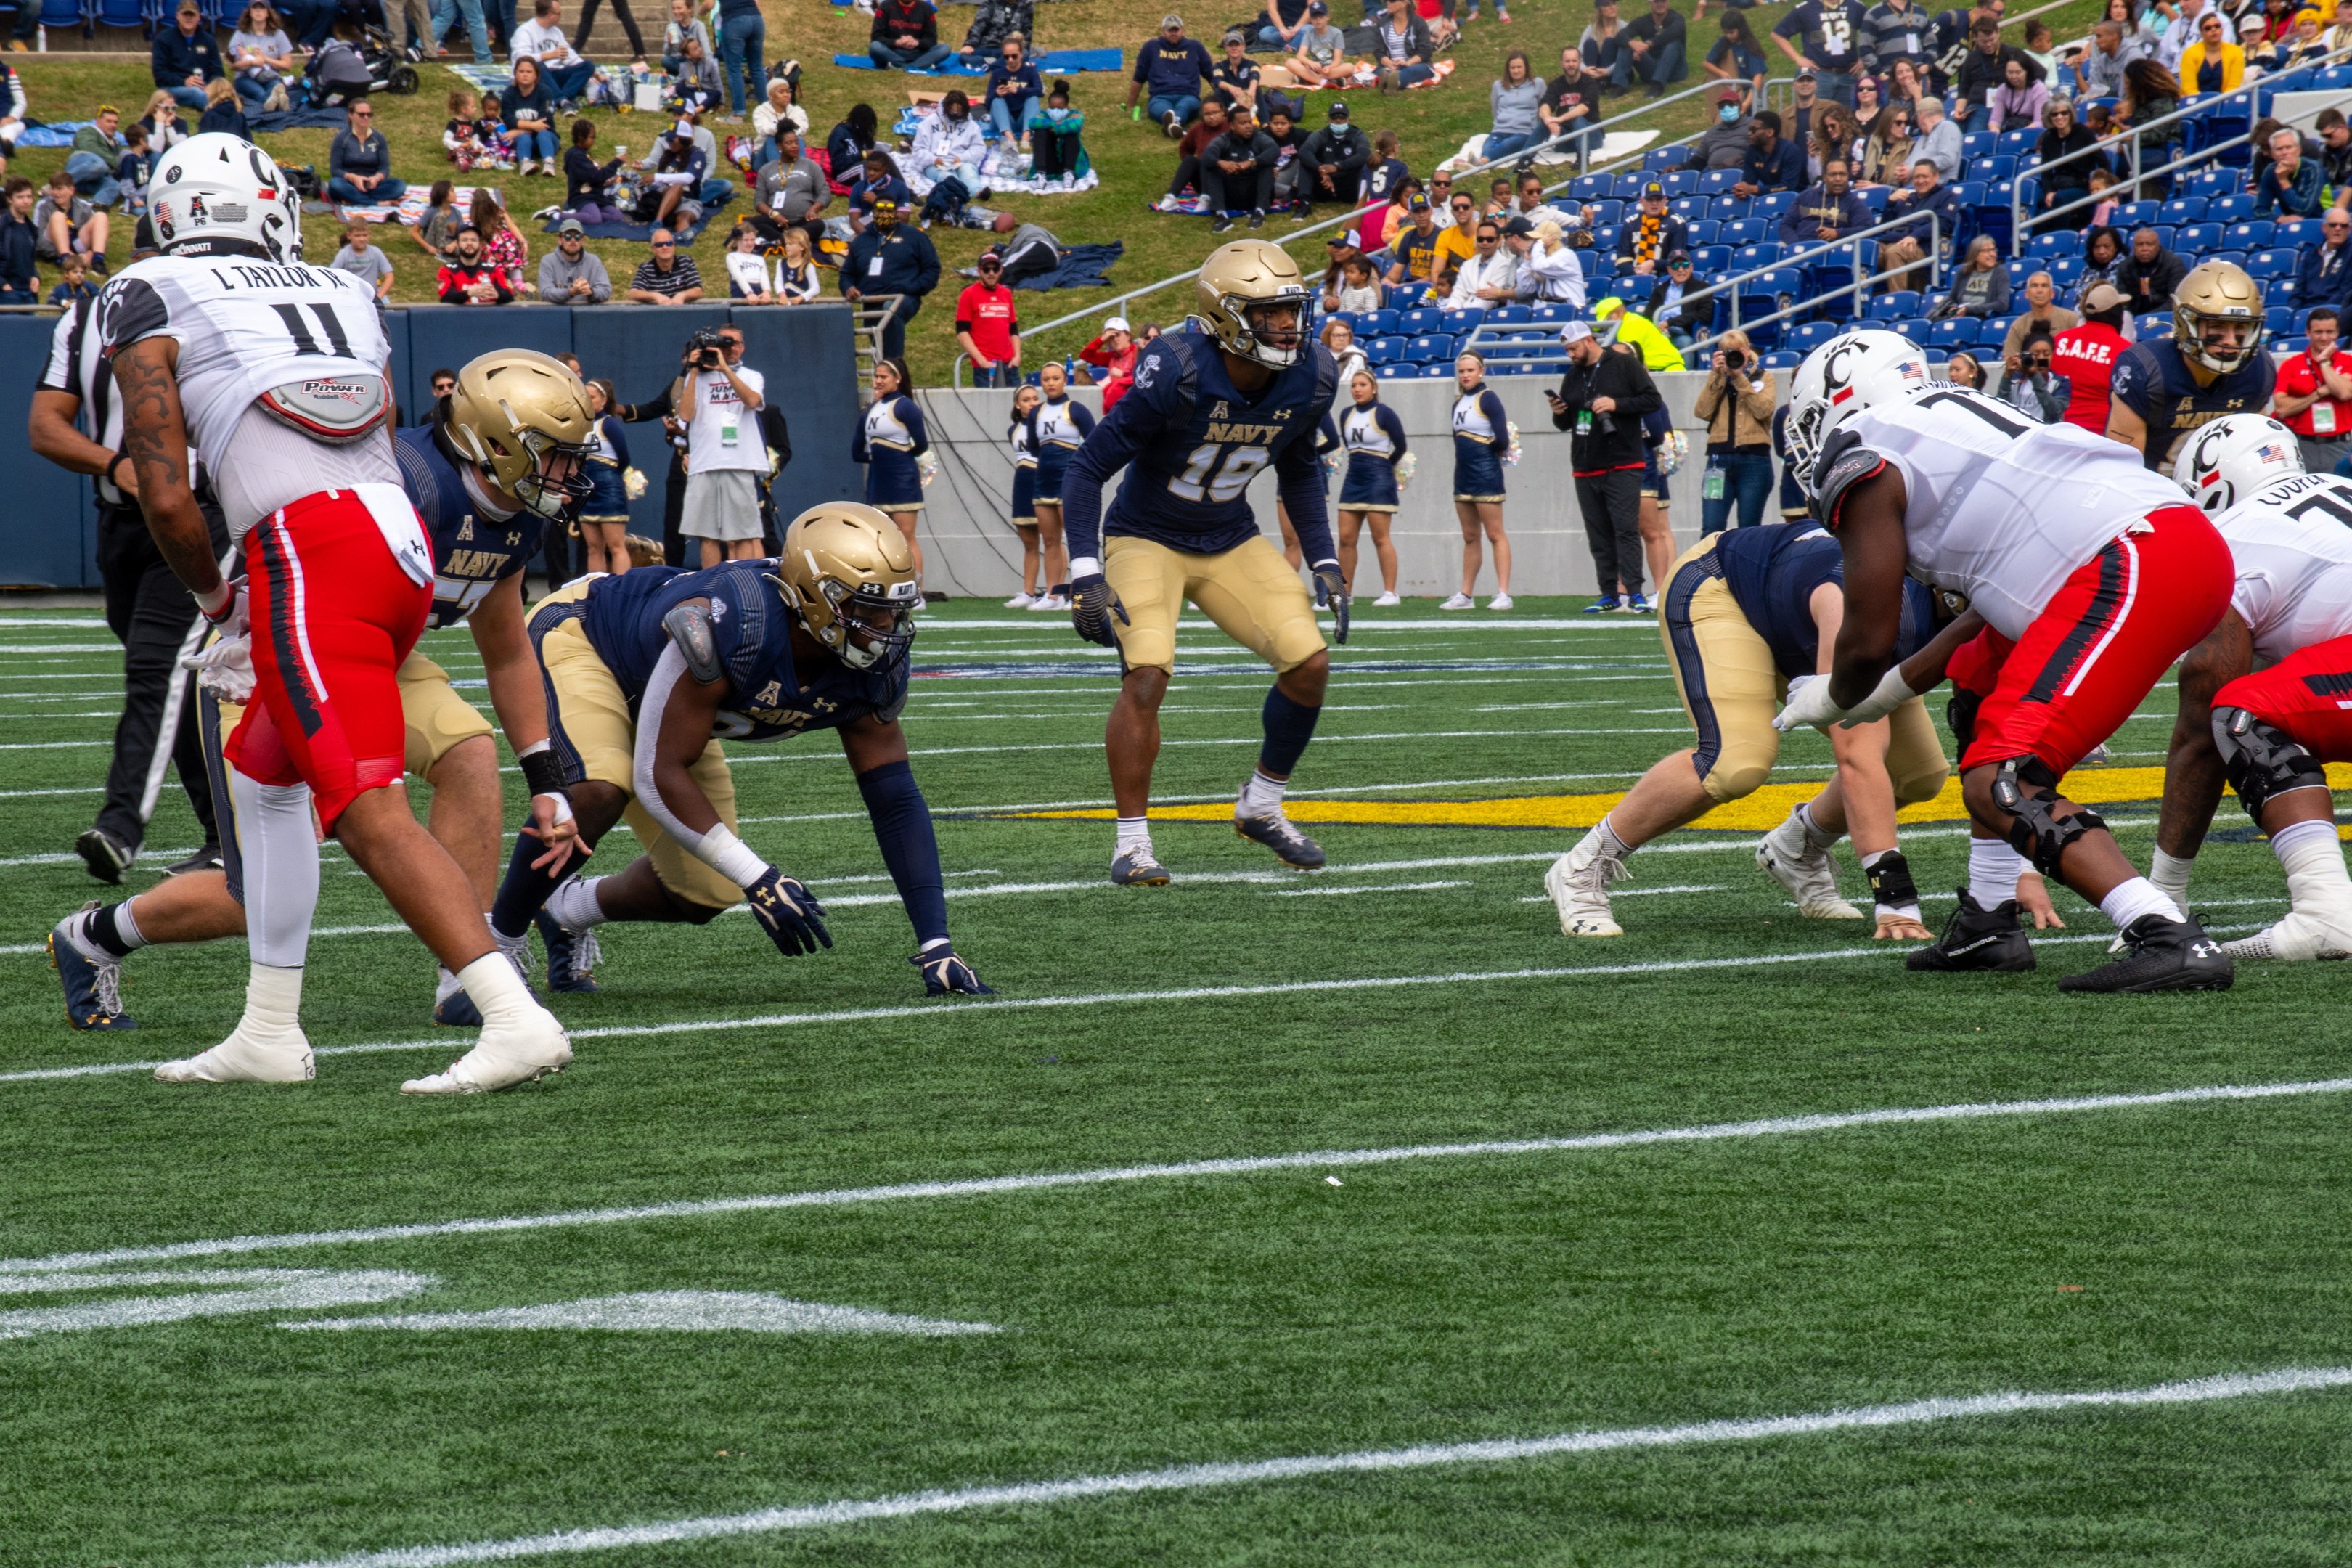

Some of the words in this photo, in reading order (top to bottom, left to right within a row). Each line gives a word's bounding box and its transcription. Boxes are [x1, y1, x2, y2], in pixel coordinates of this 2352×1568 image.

[1819, 11, 1847, 21] NAVY
[1821, 20, 1851, 52] 12
[1159, 49, 1188, 60] NAVY
[1935, 43, 1968, 76] 12
[1372, 166, 1389, 193] 5
[1632, 232, 1667, 243] NY
[211, 269, 234, 290] L
[232, 266, 321, 289] TAYLOR
[320, 269, 350, 290] JR
[269, 303, 357, 360] 11
[2057, 338, 2110, 364] S.A.F.E.
[302, 382, 366, 393] POWER
[710, 385, 732, 394] JUM
[1455, 411, 1467, 425] N
[1914, 390, 2046, 440] 7
[867, 417, 879, 430] N
[1043, 421, 1056, 435] N
[1203, 422, 1283, 444] NAVY
[1352, 428, 1364, 442] N
[1018, 439, 1026, 452] N
[443, 550, 511, 579] NAVY
[897, 584, 913, 595] NAVY
[1871, 876, 1881, 889] N
[1964, 936, 1997, 952] ARMOUR
